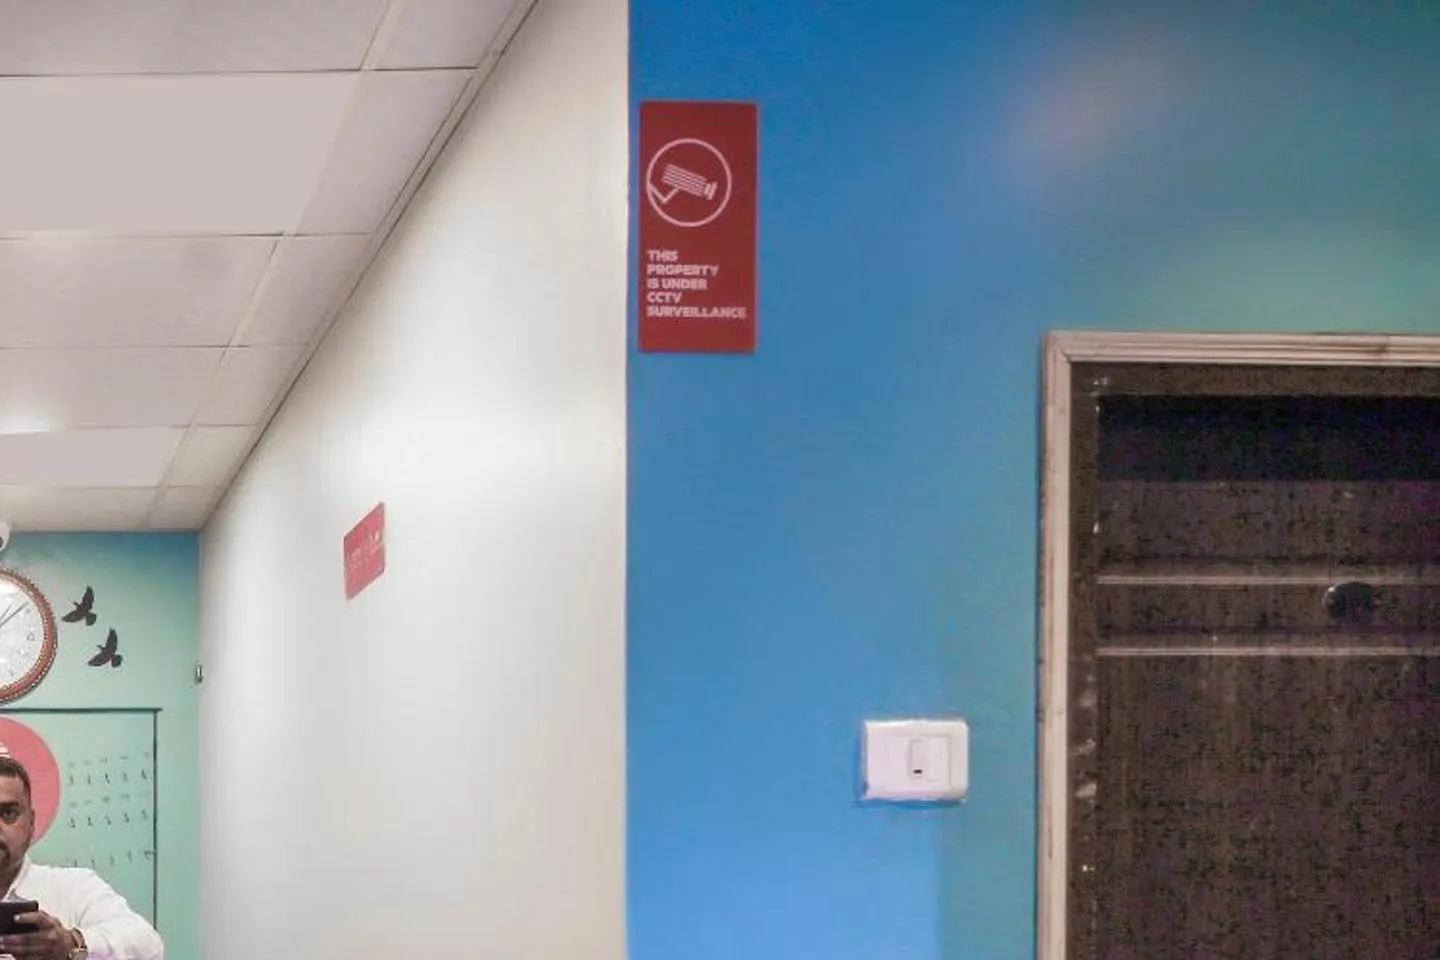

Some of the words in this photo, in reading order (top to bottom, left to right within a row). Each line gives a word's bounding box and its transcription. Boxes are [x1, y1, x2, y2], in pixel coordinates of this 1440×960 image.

[647, 250, 678, 261] THIS
[647, 264, 719, 276] PROPERTY
[647, 278, 659, 290] IS
[662, 278, 708, 290] UNDER
[647, 291, 683, 303] CCTV
[647, 305, 747, 318] SURVEILLANCE
